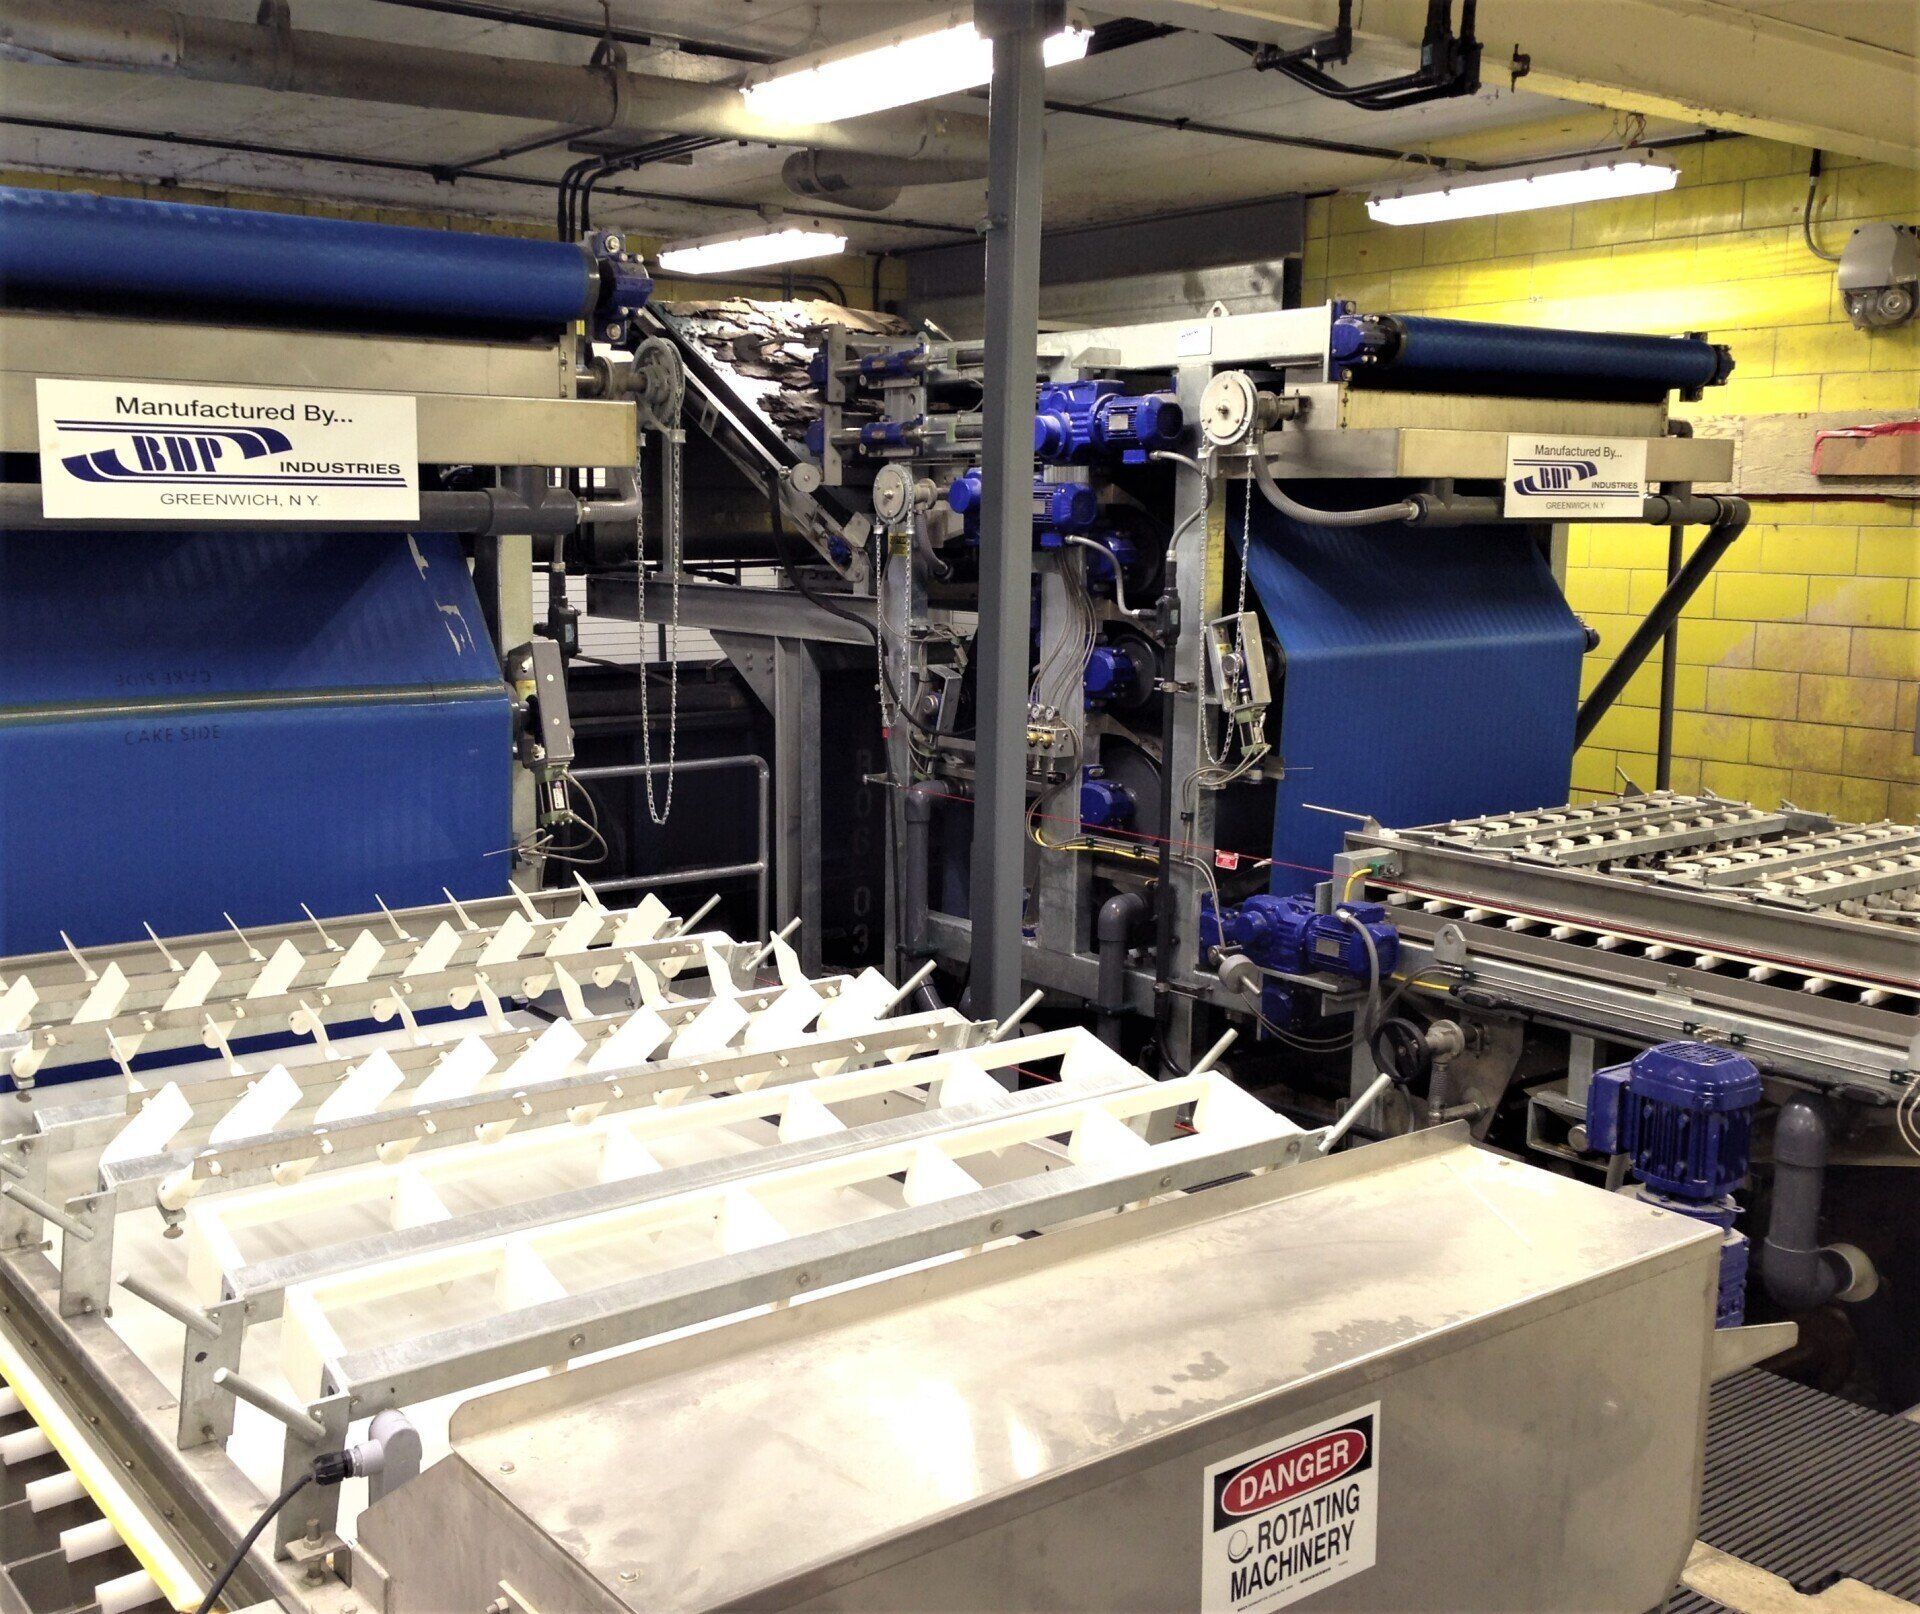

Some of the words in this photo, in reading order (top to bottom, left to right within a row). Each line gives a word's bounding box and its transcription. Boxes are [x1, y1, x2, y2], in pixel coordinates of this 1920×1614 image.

[115, 396, 295, 421] Manufactured
[304, 405, 353, 427] By...
[131, 435, 222, 472] BDP
[1535, 444, 1600, 457] Manufactured
[1603, 447, 1622, 460] By...
[280, 461, 401, 475] INDUSTRIES
[1539, 467, 1572, 489] BDP
[1591, 481, 1638, 489] INDUSTRIES
[160, 493, 283, 507] GREENWICH,
[125, 728, 173, 746] CAKE
[181, 725, 221, 742] SIDE
[1240, 1438, 1349, 1507] DANGER
[1258, 1483, 1360, 1554] ROTATING
[1231, 1519, 1355, 1603] MACHINERY
